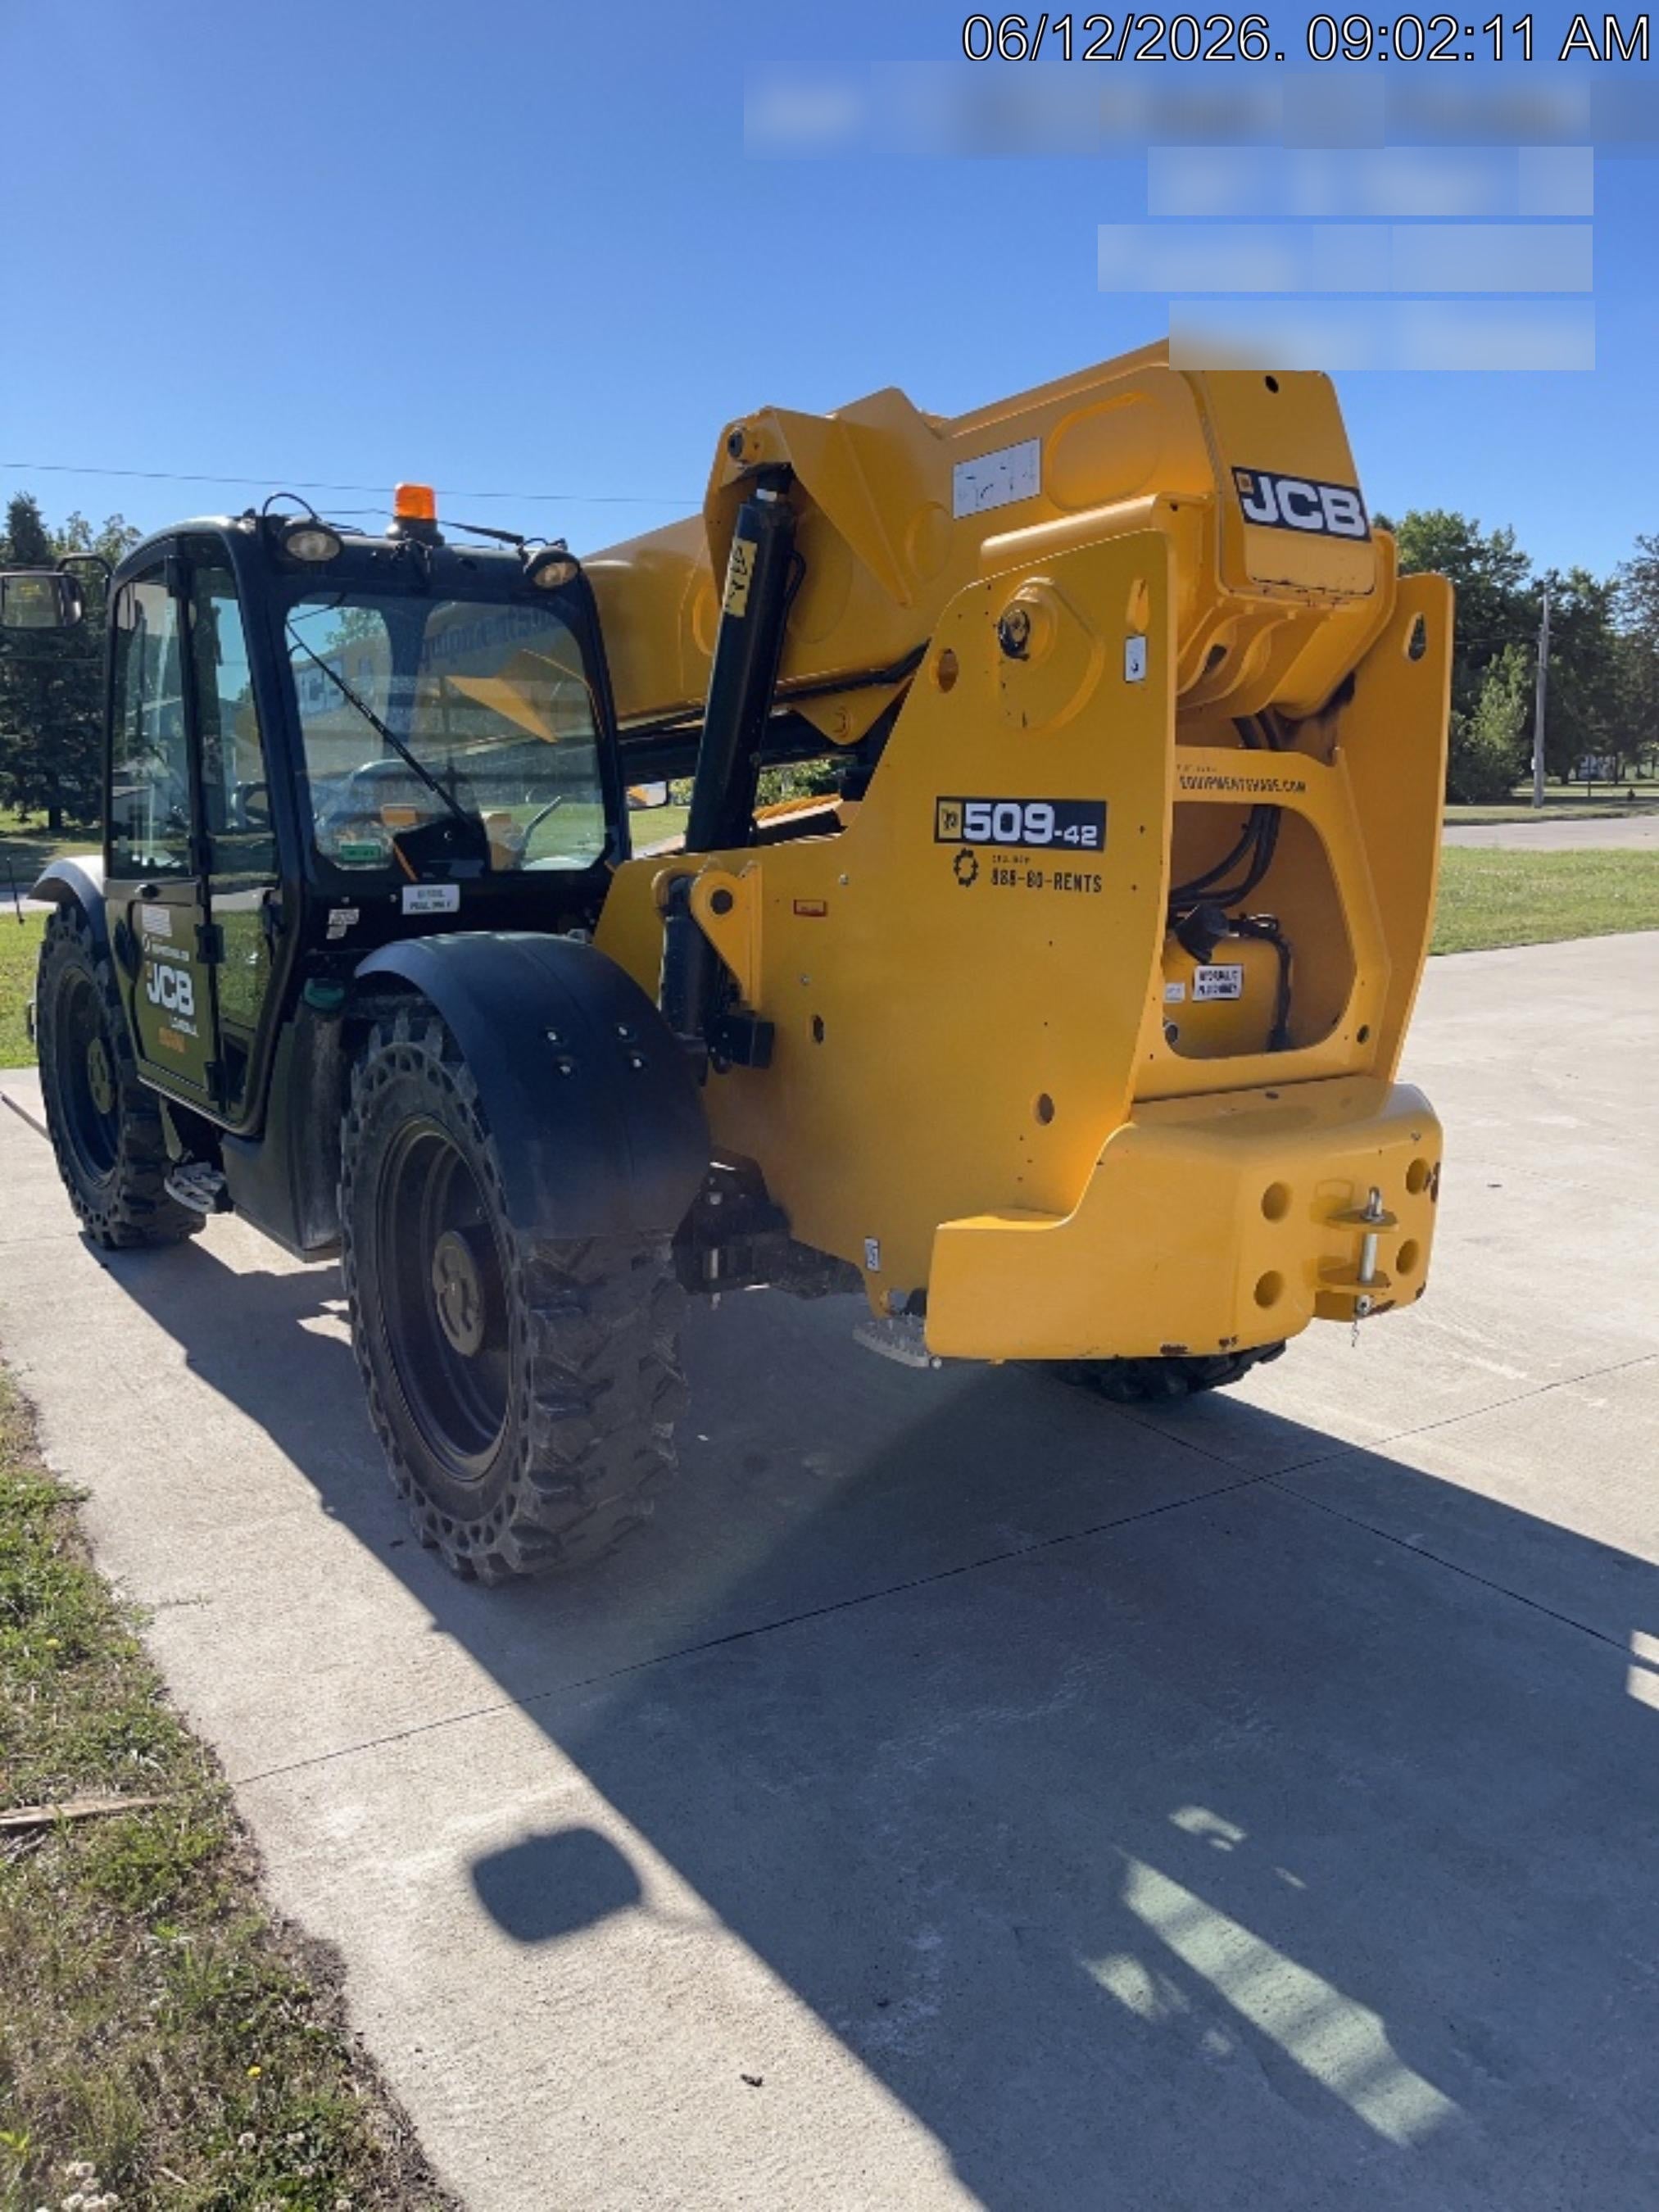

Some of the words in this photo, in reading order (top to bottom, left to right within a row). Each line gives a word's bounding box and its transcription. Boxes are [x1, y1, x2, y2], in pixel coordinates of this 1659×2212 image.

[1242, 475, 1367, 537] JCB
[963, 803, 1098, 845] 509-42
[147, 962, 195, 1017] JCB
